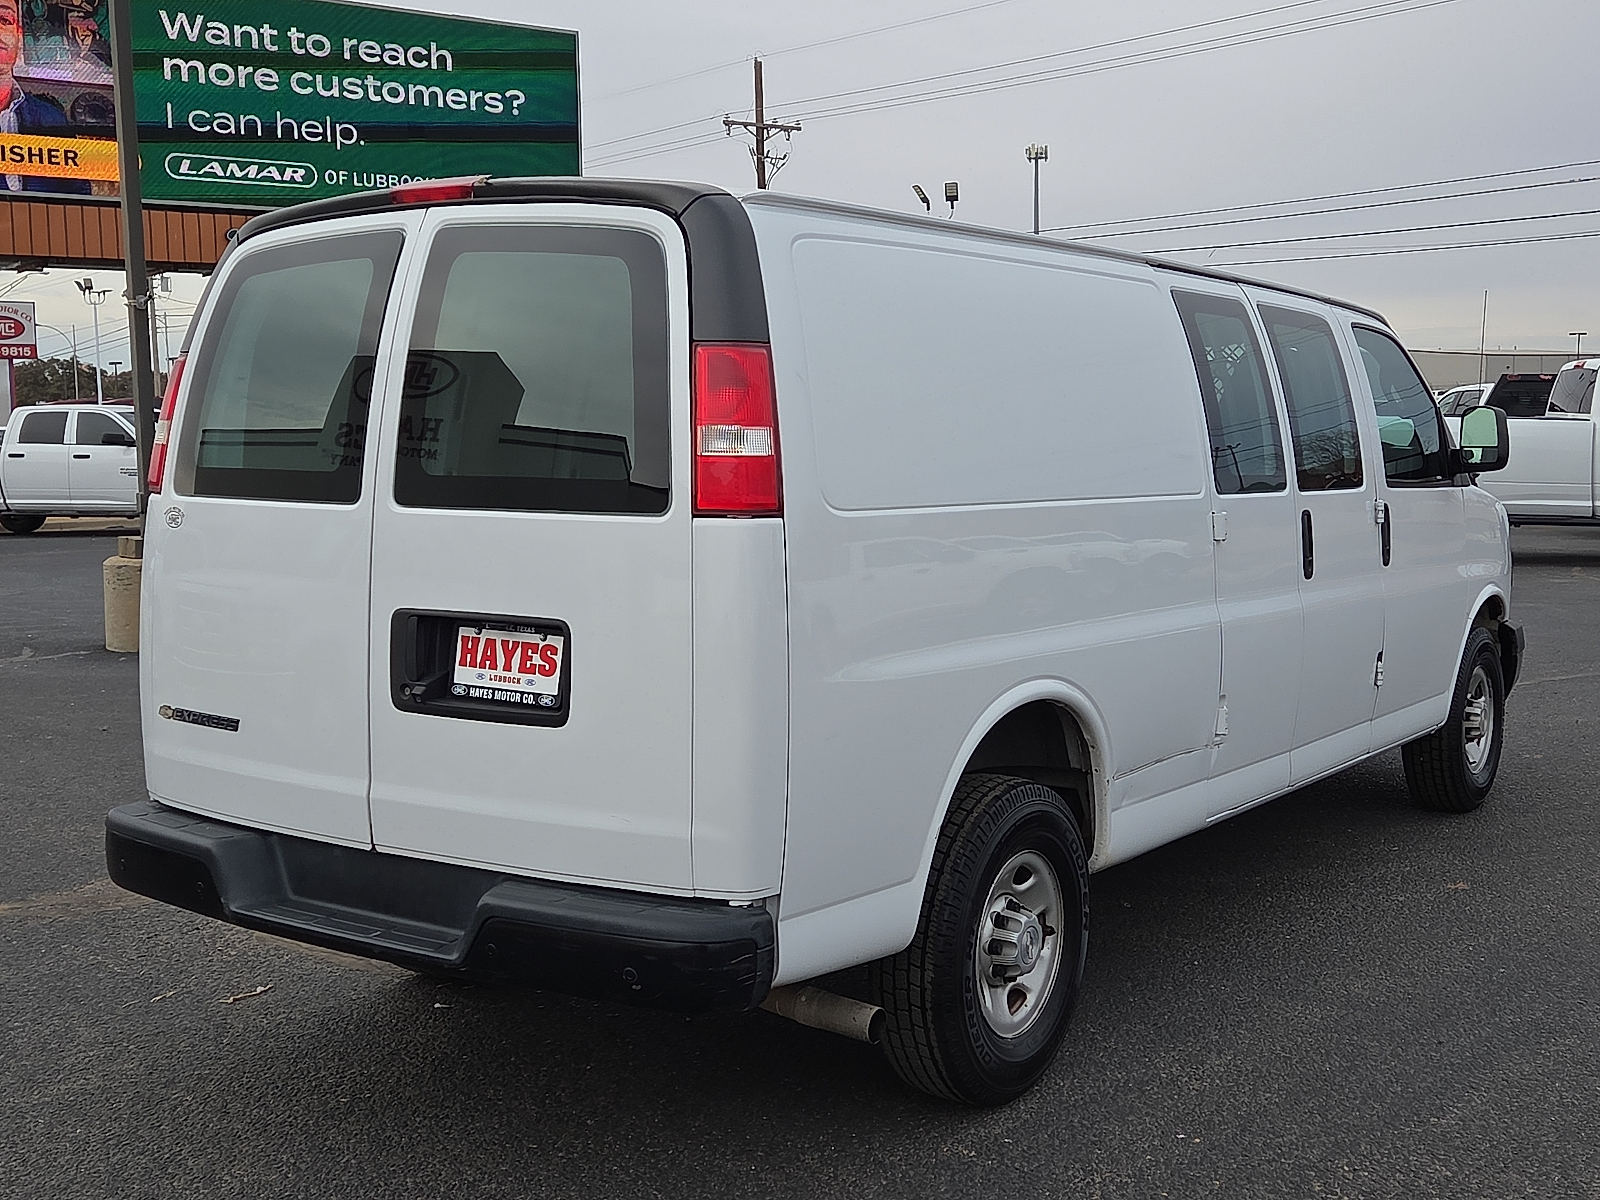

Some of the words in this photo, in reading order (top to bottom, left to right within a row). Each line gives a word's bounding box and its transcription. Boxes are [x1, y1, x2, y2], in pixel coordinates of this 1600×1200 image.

[158, 9, 279, 52] Want
[287, 26, 331, 57] to
[342, 37, 453, 71] reach
[163, 57, 279, 91] more
[290, 71, 526, 116] customers?
[166, 101, 173, 129] I
[187, 109, 262, 137] can
[276, 110, 365, 150] help.
[0, 144, 79, 167] ISHER
[178, 158, 306, 182] LAMAR
[324, 169, 348, 186] OF
[353, 172, 436, 188] LUBBO
[458, 635, 559, 677] HAYES
[488, 674, 522, 685] LUBBOCK
[469, 687, 493, 699] HAYES
[493, 690, 521, 703] MOTOR
[522, 694, 536, 705] CO.
[173, 708, 239, 731] EXPRESS
